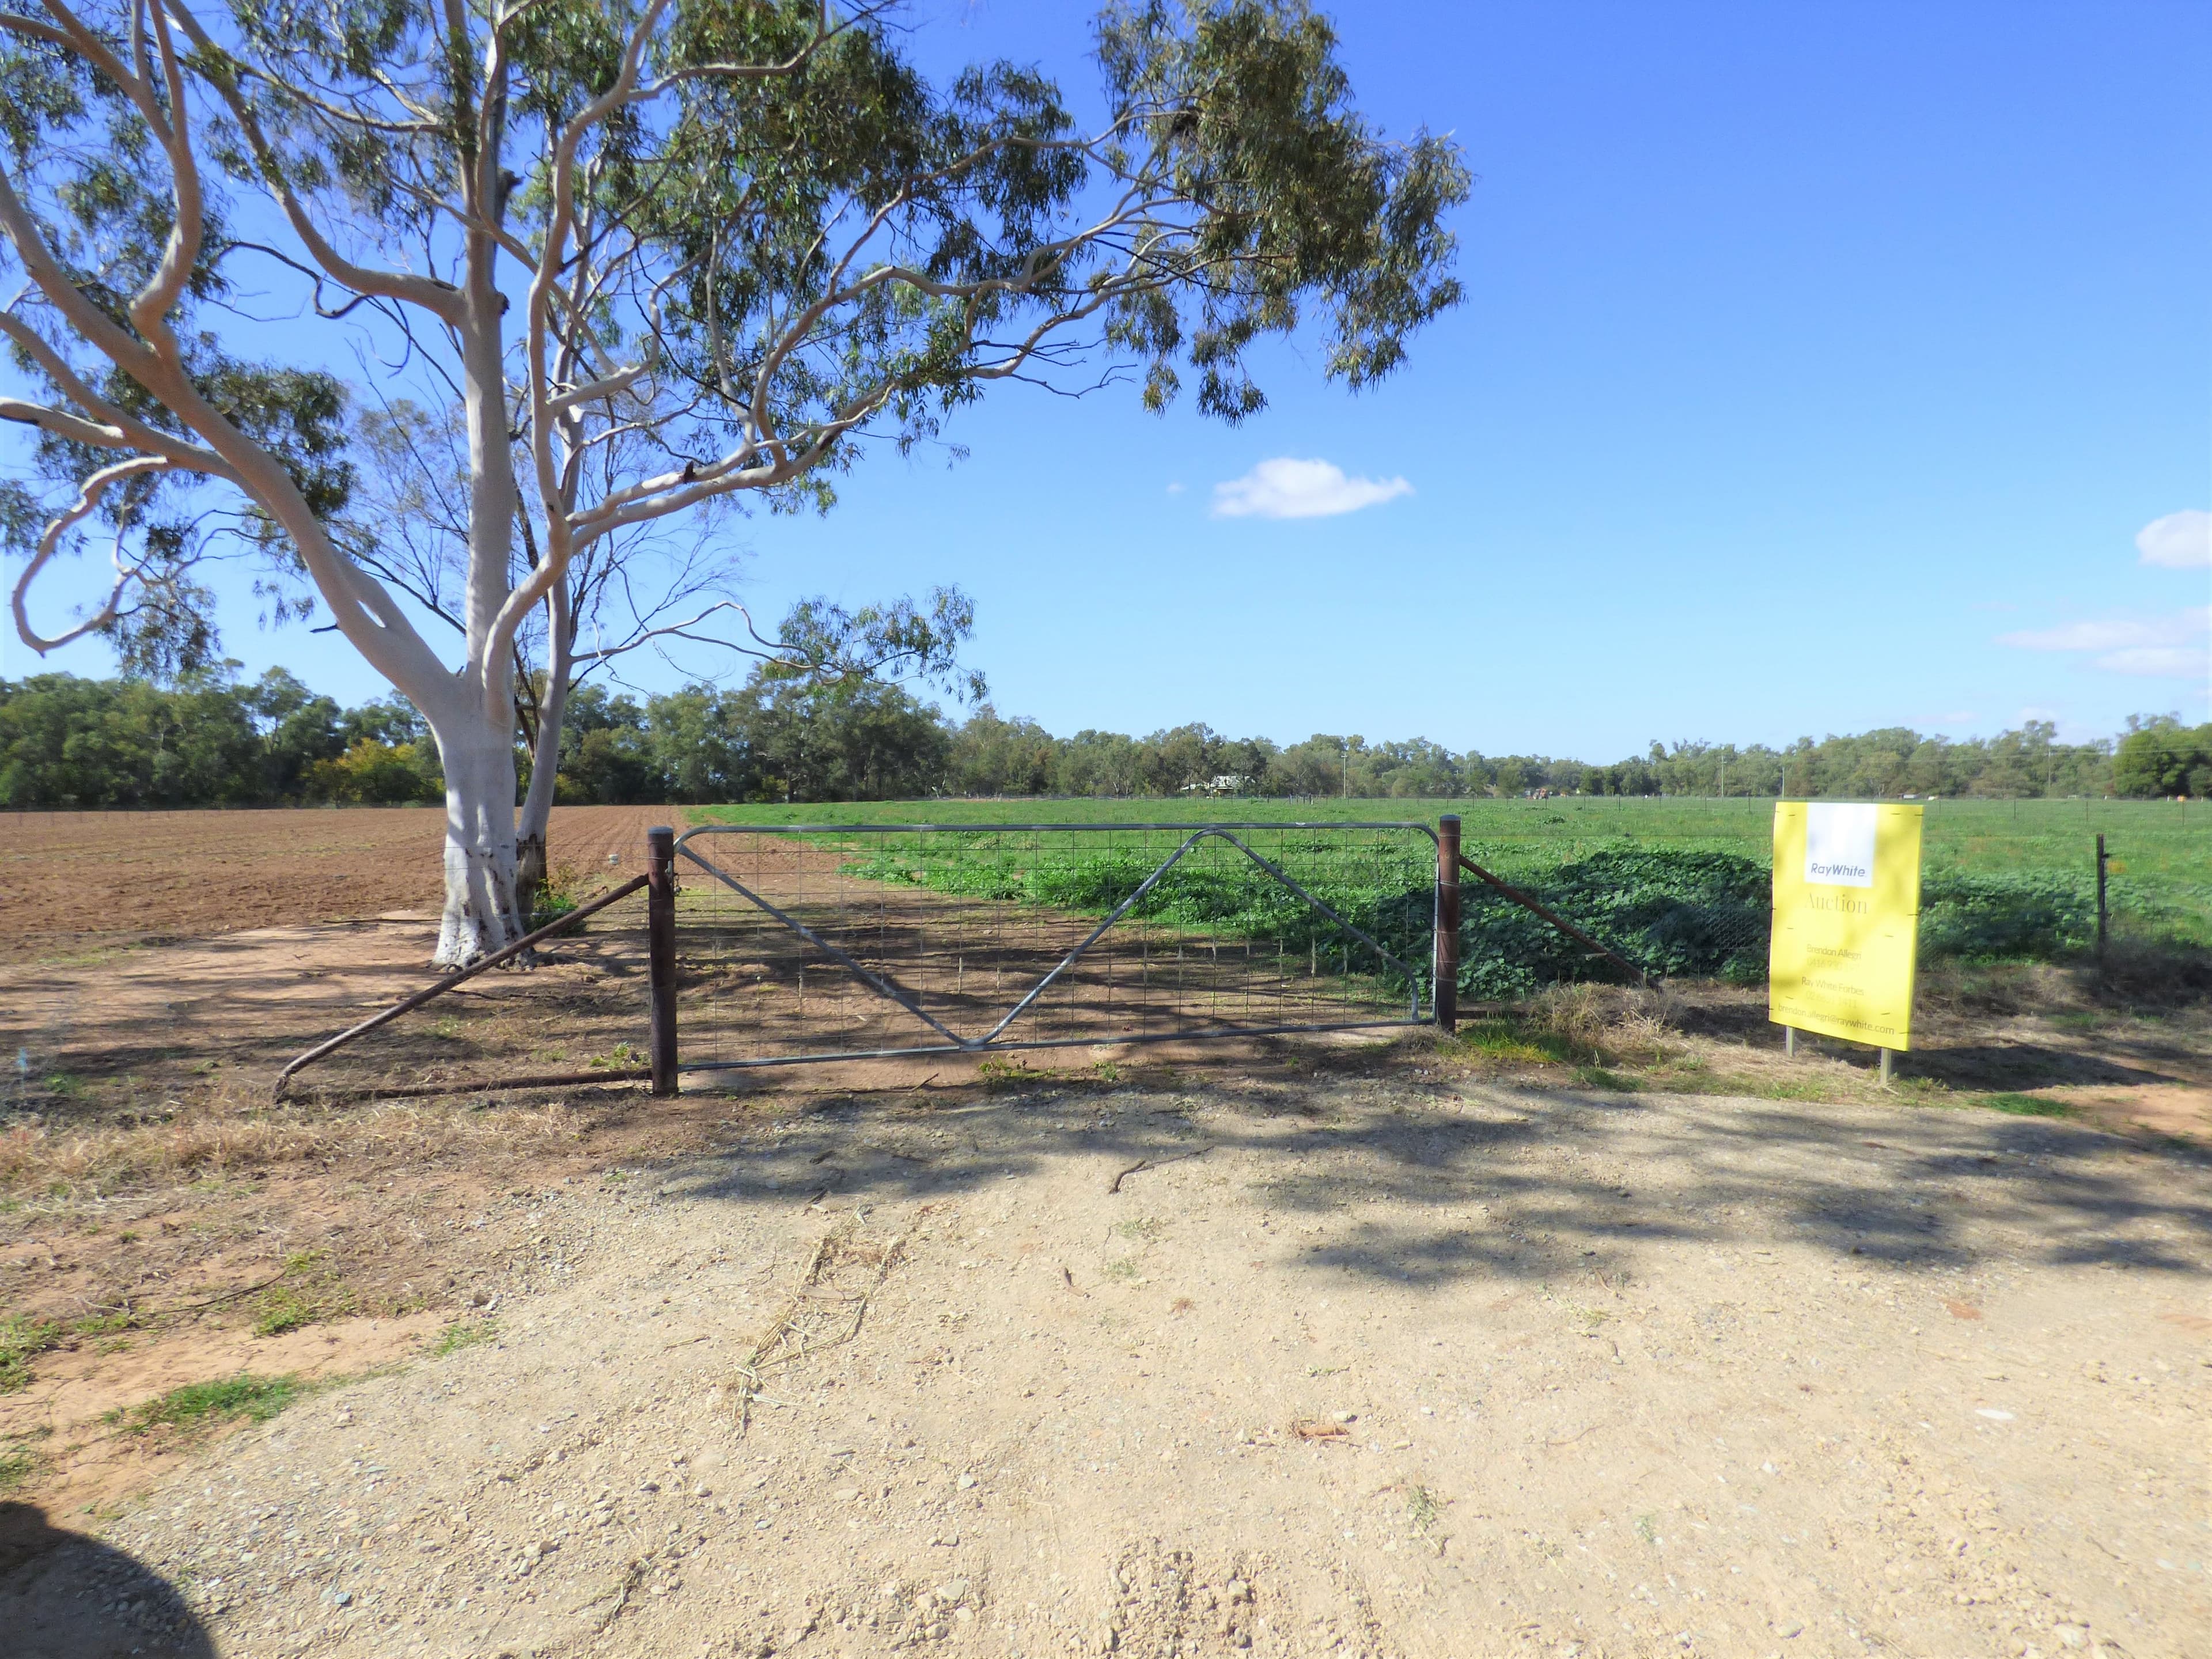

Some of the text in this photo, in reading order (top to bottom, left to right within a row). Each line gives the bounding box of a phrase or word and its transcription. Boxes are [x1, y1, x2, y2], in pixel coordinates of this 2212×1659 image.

[1805, 892, 1867, 914] Auction
[1806, 944, 1861, 961] Brendon Allegri
[1802, 976, 1864, 997] Ray White Forbes
[1778, 1003, 1895, 1035] brendon.allegri@raywhite.com
